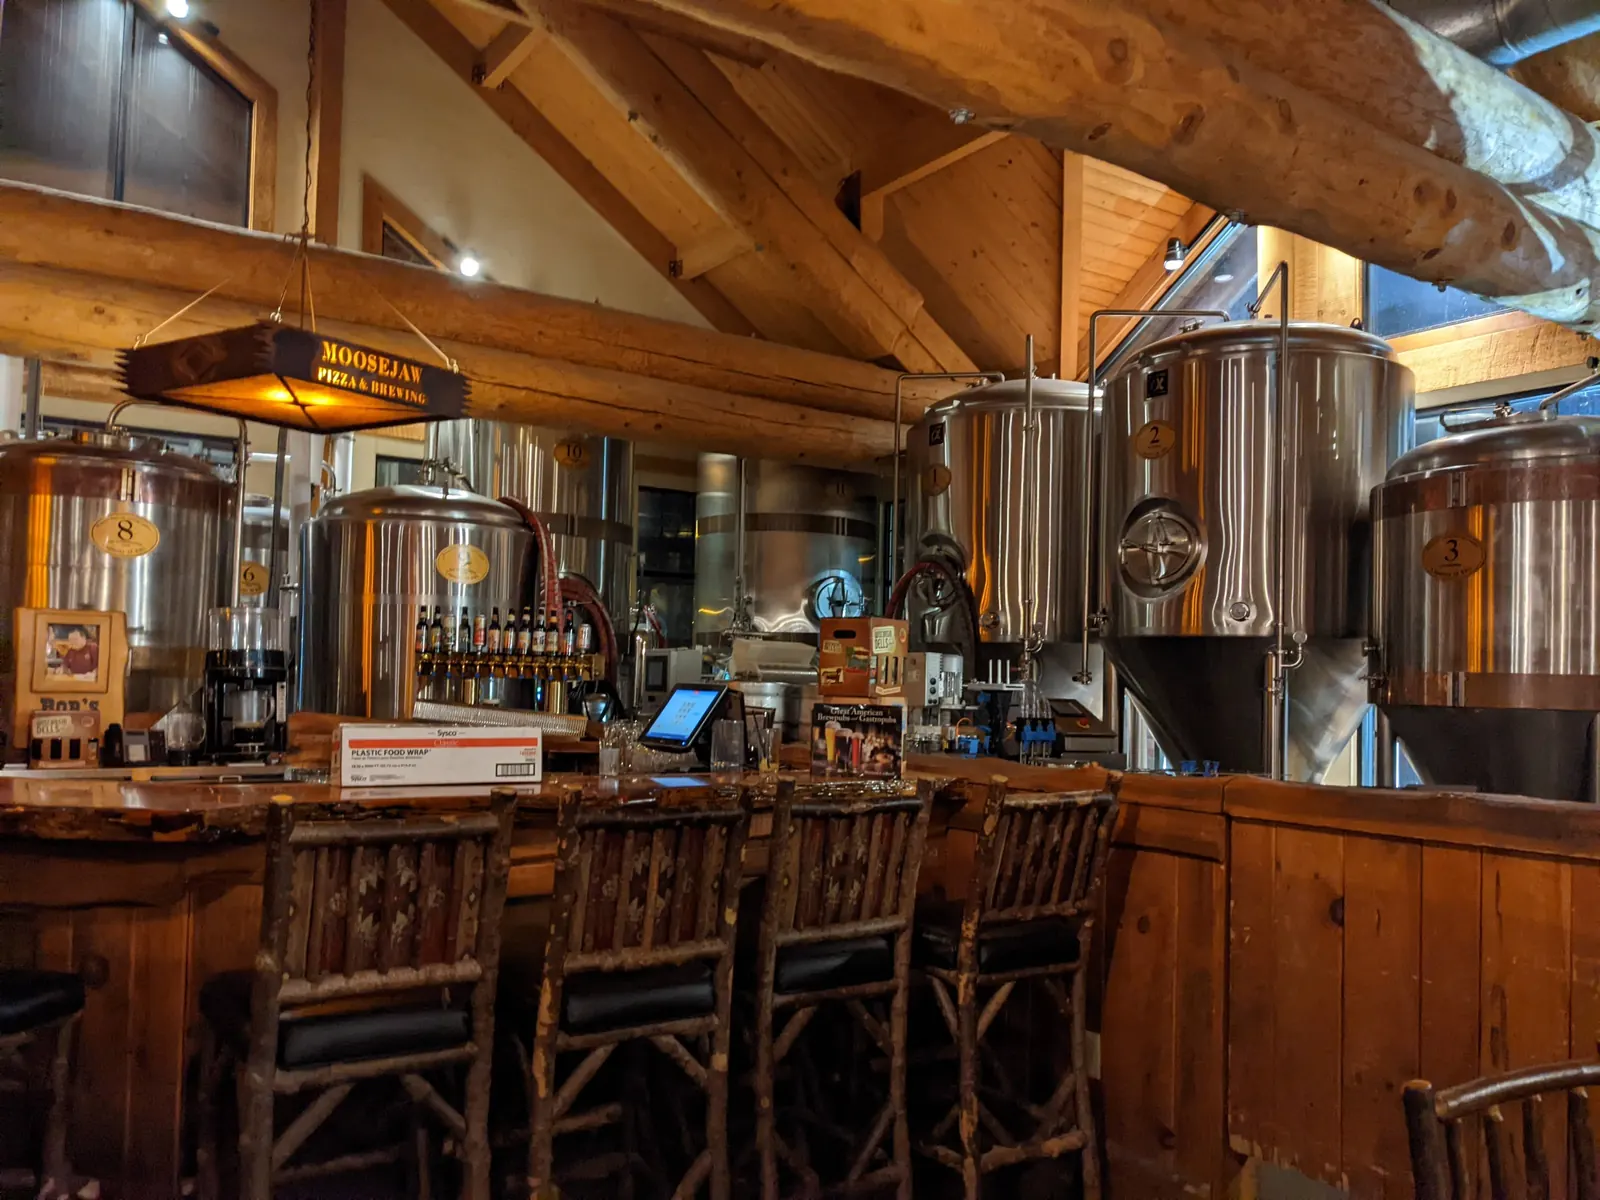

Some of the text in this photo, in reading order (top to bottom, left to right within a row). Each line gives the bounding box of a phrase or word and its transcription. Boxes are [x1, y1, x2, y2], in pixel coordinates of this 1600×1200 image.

[322, 341, 423, 384] MOOSEJAW
[318, 366, 426, 405] PIZZA & BREWING
[1149, 426, 1160, 444] 2
[567, 444, 582, 460] 10
[118, 519, 133, 541] 8
[1444, 539, 1459, 562] 3
[243, 567, 255, 582] 6
[817, 712, 850, 723] Brewpubs
[859, 714, 897, 725] Gastropubs
[830, 706, 884, 717] Great American
[437, 729, 457, 737] Sysco
[351, 749, 383, 757] PLASTIC
